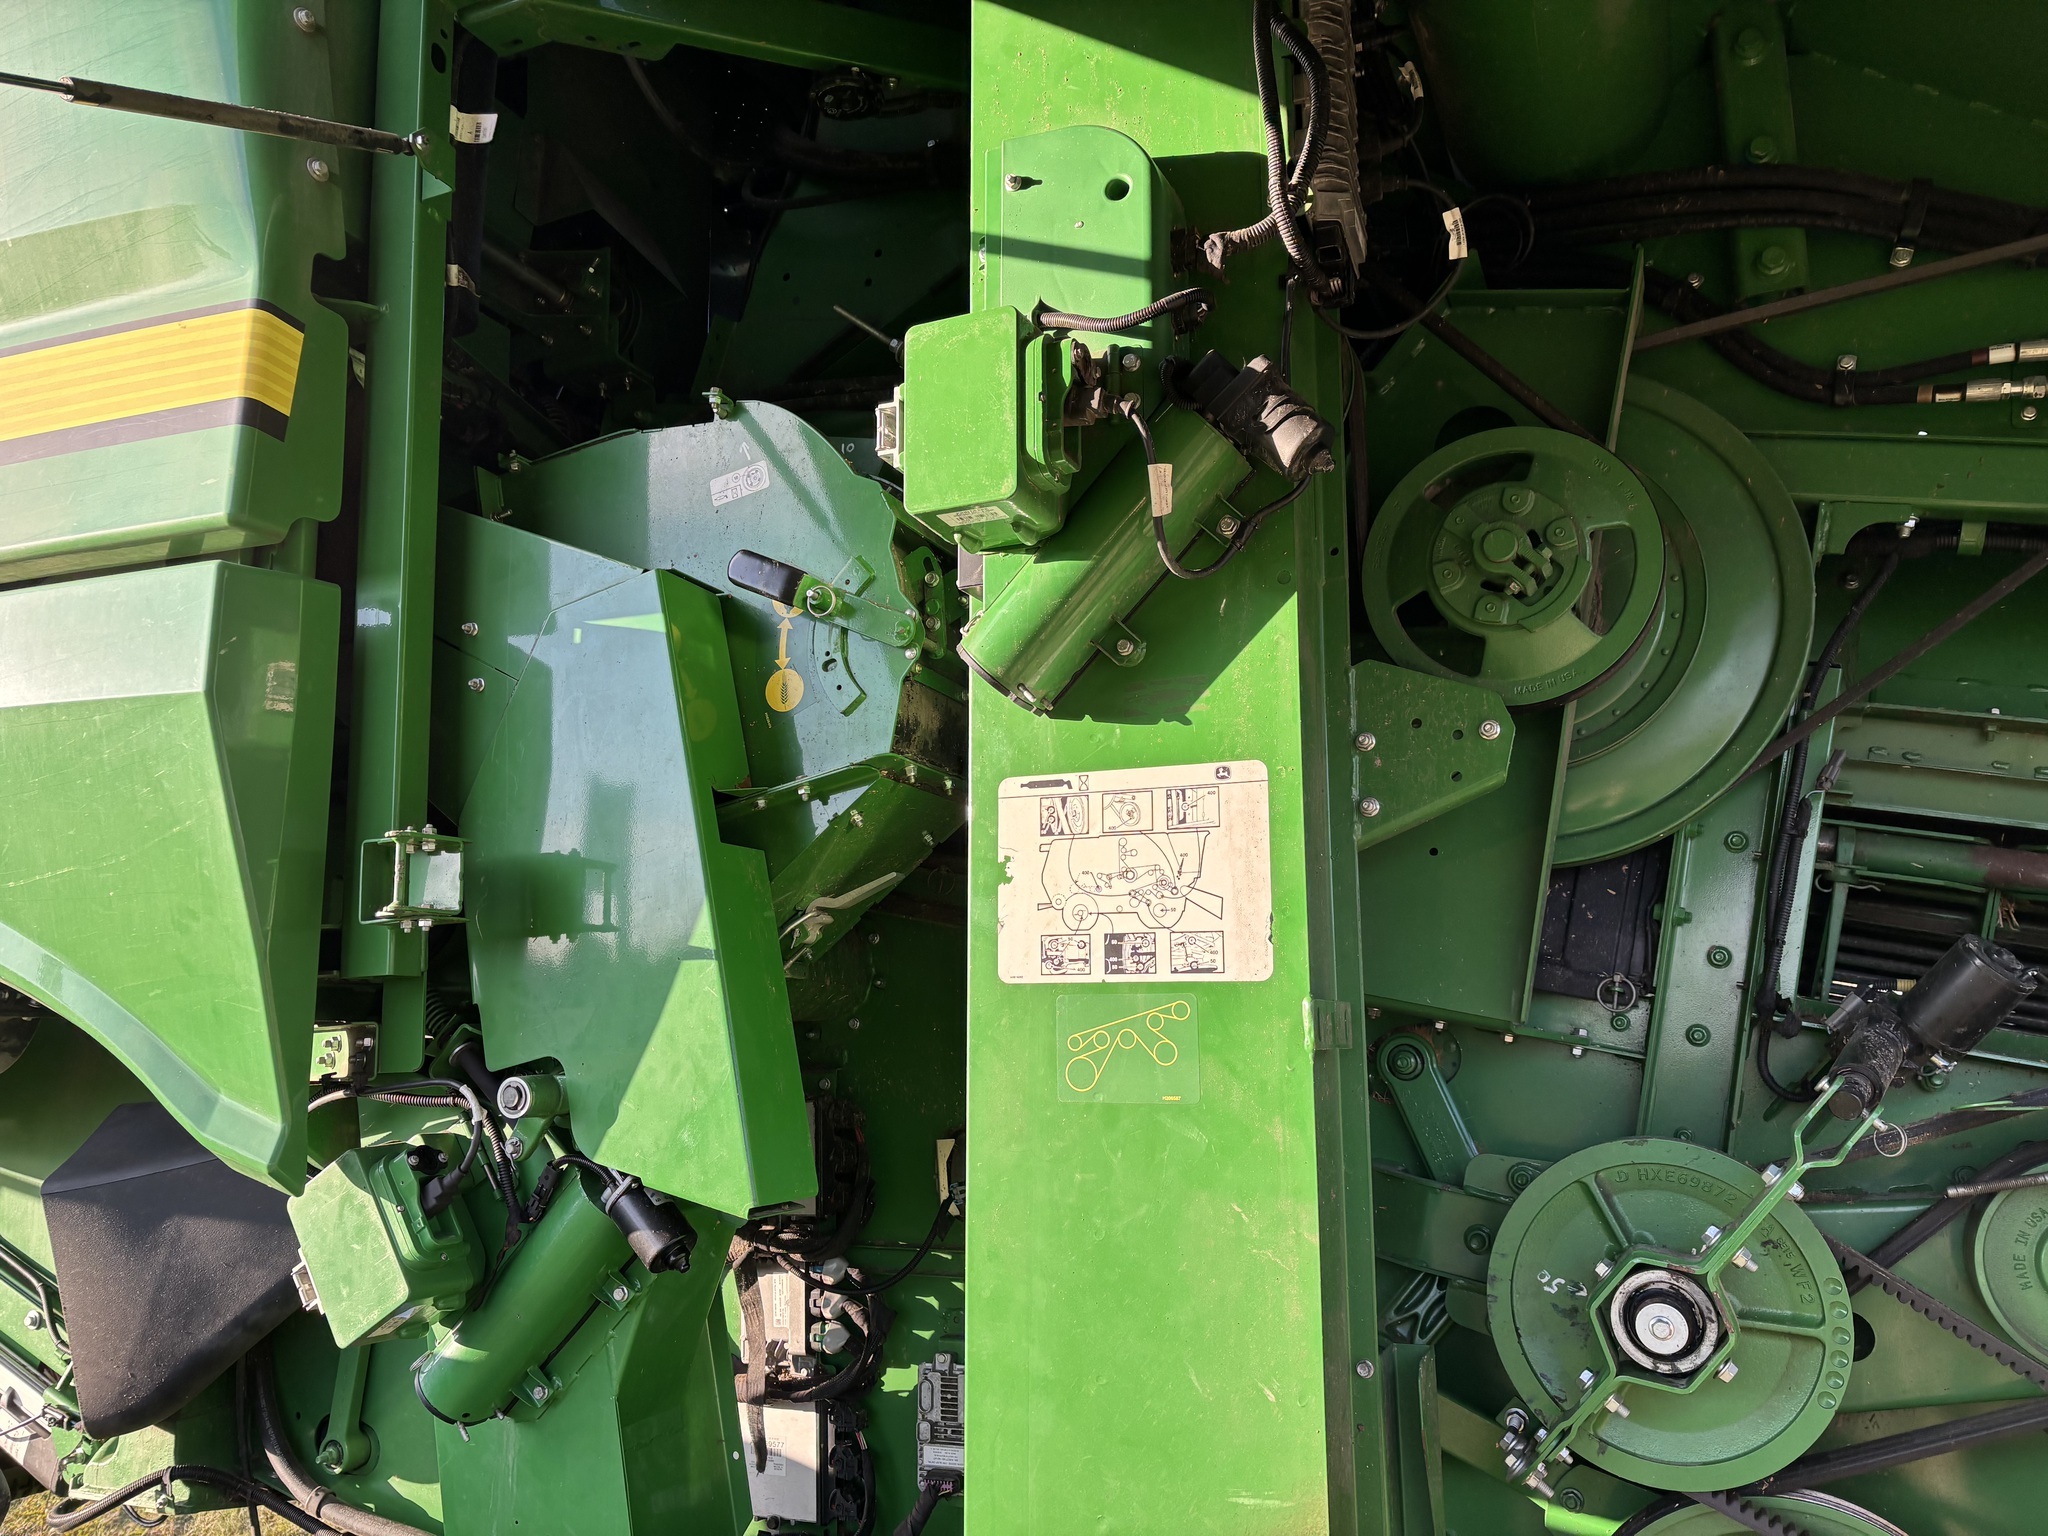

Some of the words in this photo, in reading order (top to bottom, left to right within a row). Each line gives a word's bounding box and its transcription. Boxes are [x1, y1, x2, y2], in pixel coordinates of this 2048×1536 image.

[841, 442, 855, 454] 10
[1513, 682, 1543, 695] MADE
[1545, 677, 1557, 688] IN
[1557, 669, 1577, 682] USA
[1636, 1167, 1738, 1207] HXE69872
[2024, 1207, 2048, 1228] USA
[2014, 1229, 2031, 1247] IN
[2012, 1253, 2034, 1291] MADE
